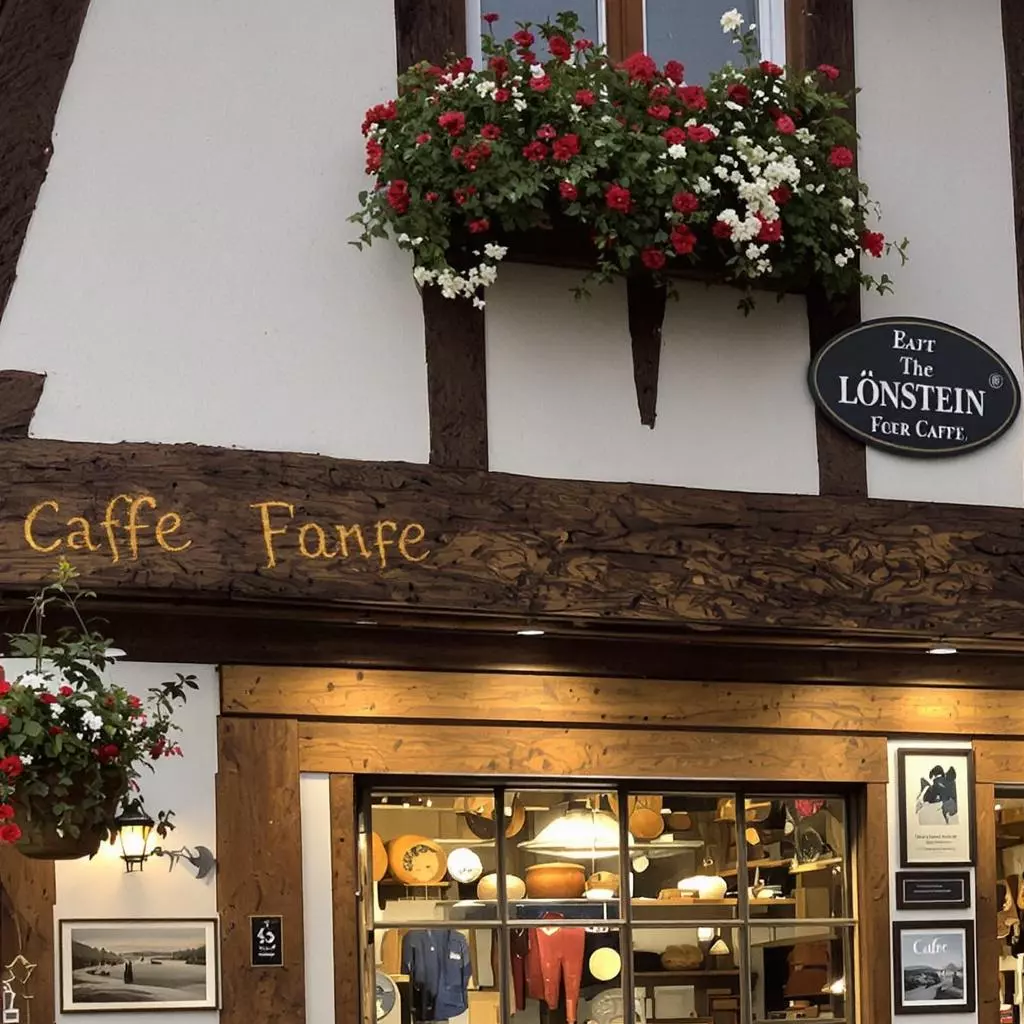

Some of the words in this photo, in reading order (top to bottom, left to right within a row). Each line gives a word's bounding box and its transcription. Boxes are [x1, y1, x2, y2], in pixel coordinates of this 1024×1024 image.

[899, 356, 934, 377] The
[838, 369, 986, 417] LÖNSTEIN
[24, 494, 193, 563] Caffe
